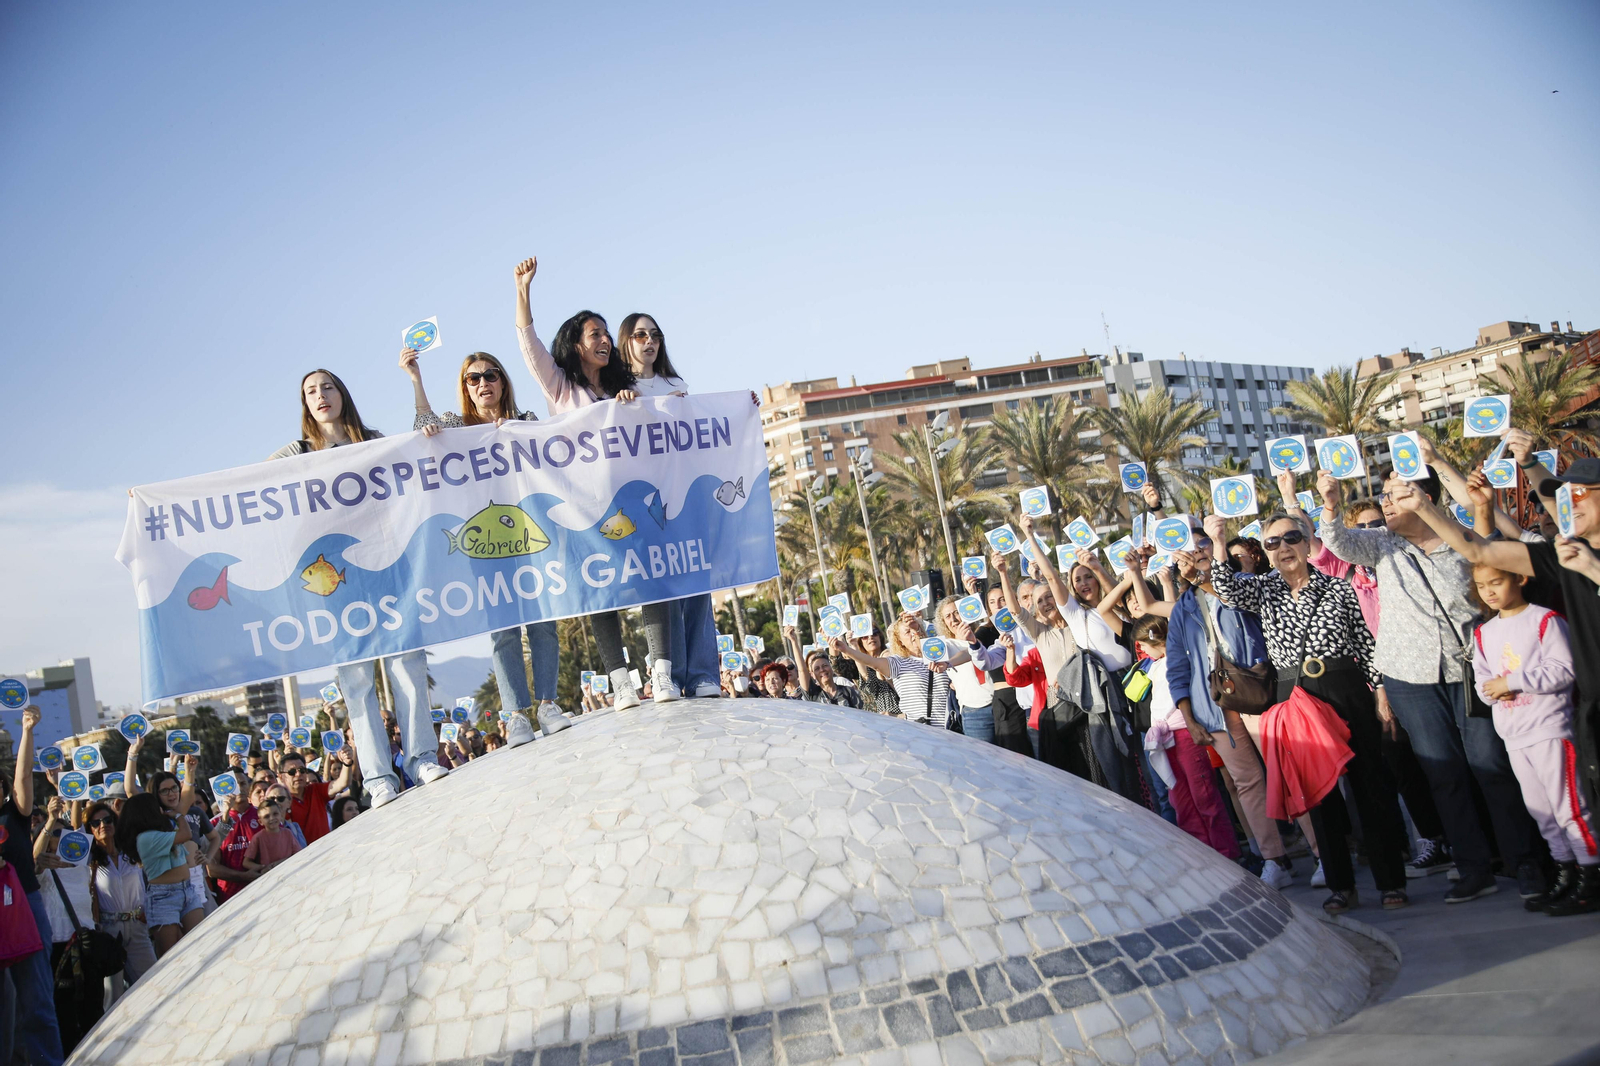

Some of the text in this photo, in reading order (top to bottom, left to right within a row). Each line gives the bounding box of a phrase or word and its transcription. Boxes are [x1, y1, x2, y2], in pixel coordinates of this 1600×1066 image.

[145, 417, 731, 541] #NUESTROSPECESNOSEVENDEN
[243, 538, 712, 657] TODOS SOMOS GABRIEL
[461, 526, 531, 555] Gabriel
